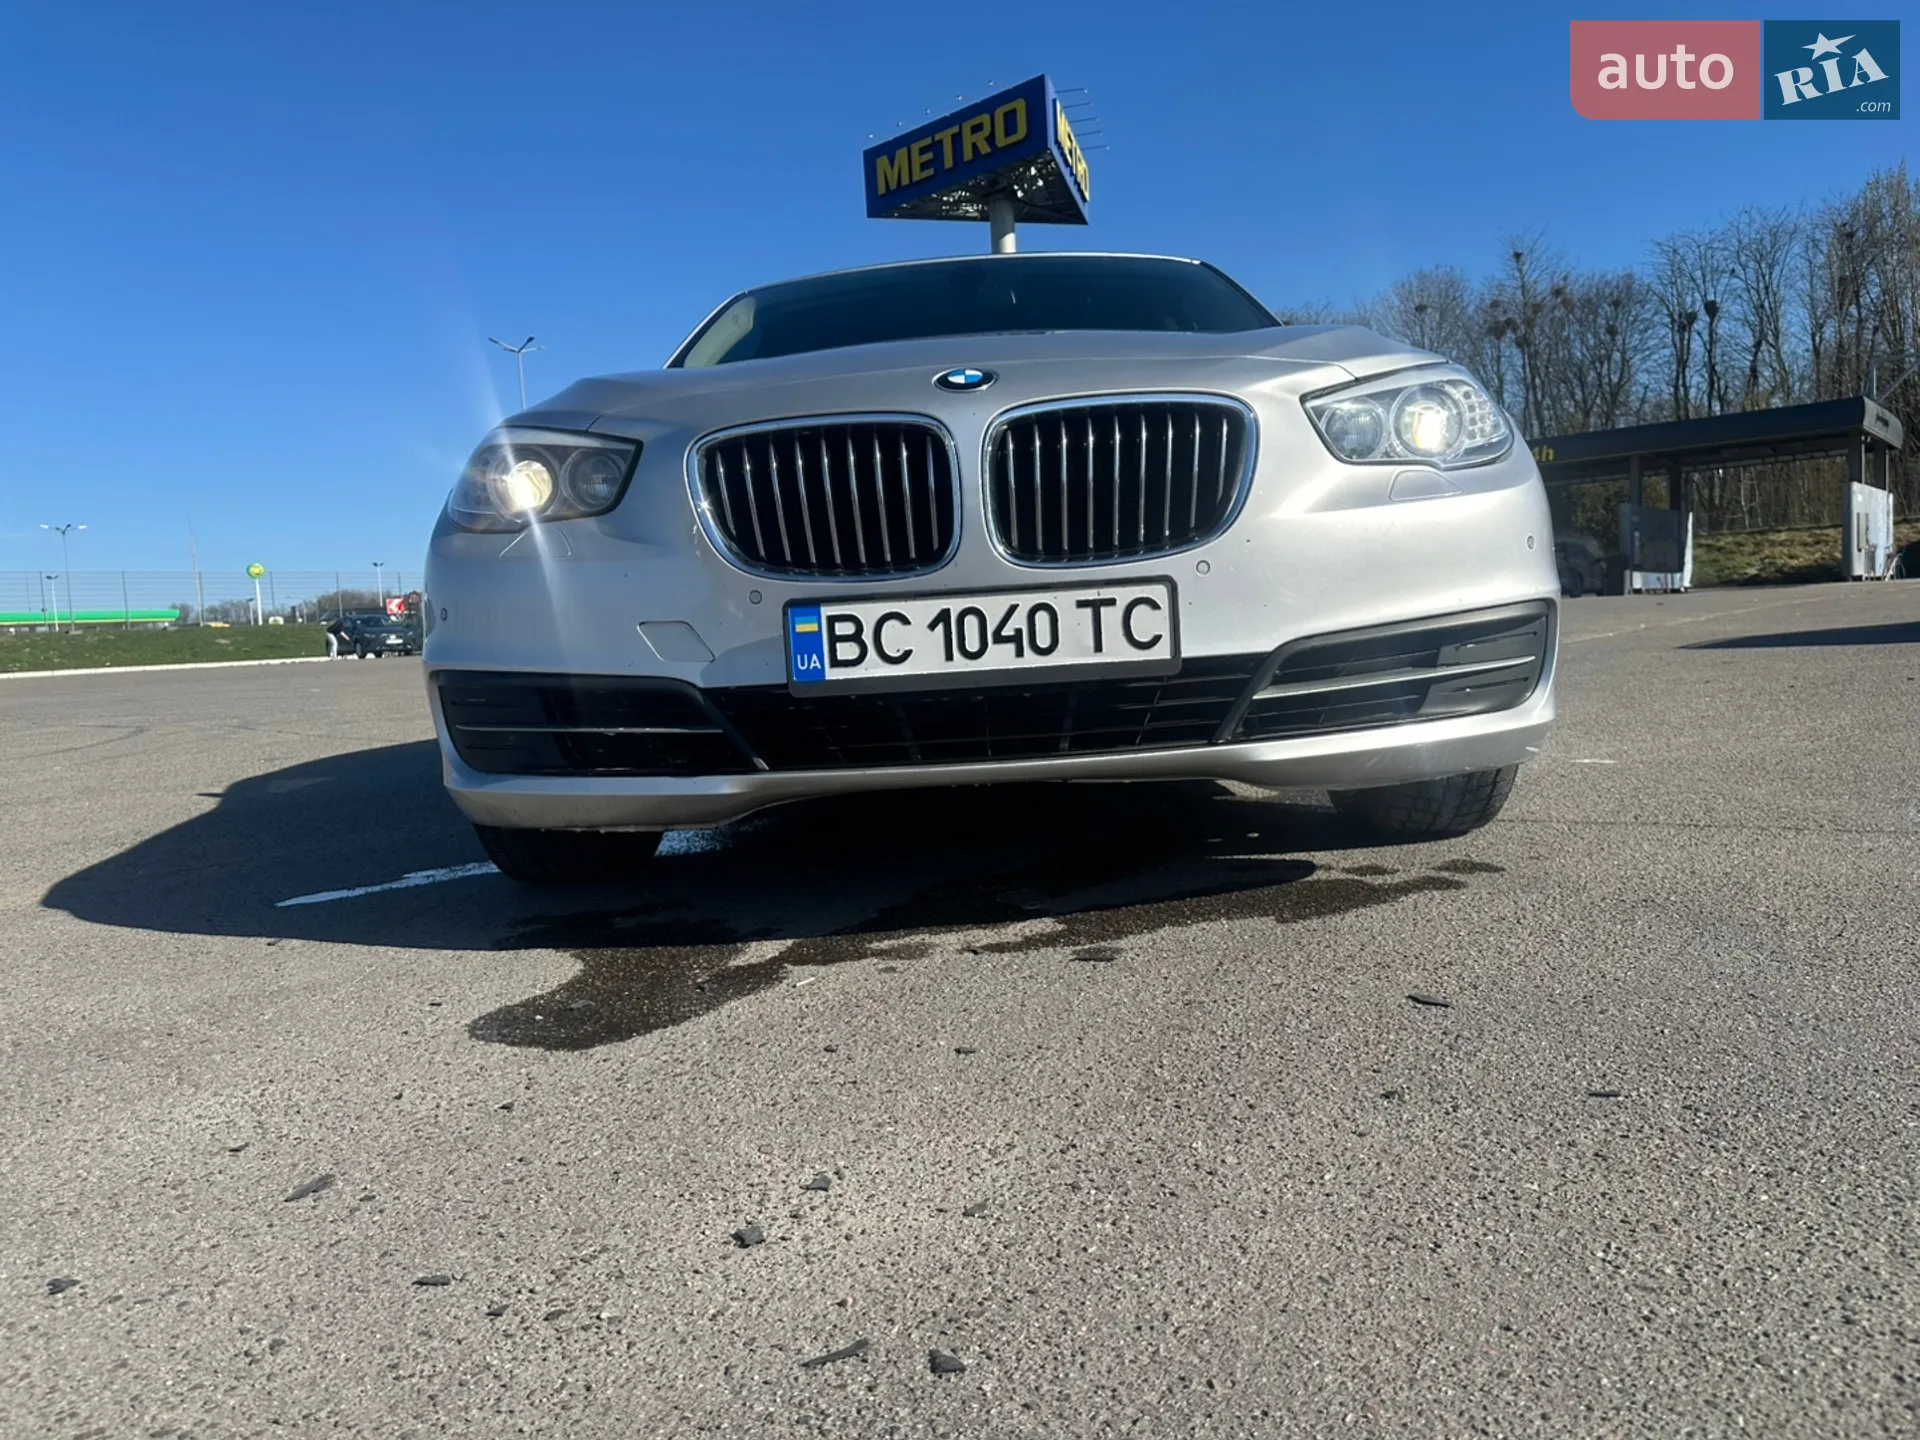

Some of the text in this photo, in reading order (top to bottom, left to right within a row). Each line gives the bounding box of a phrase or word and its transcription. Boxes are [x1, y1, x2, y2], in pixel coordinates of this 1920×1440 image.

[876, 98, 1027, 195] METRO
[797, 653, 821, 670] UA
[827, 596, 1163, 668] BC 1040 TC
